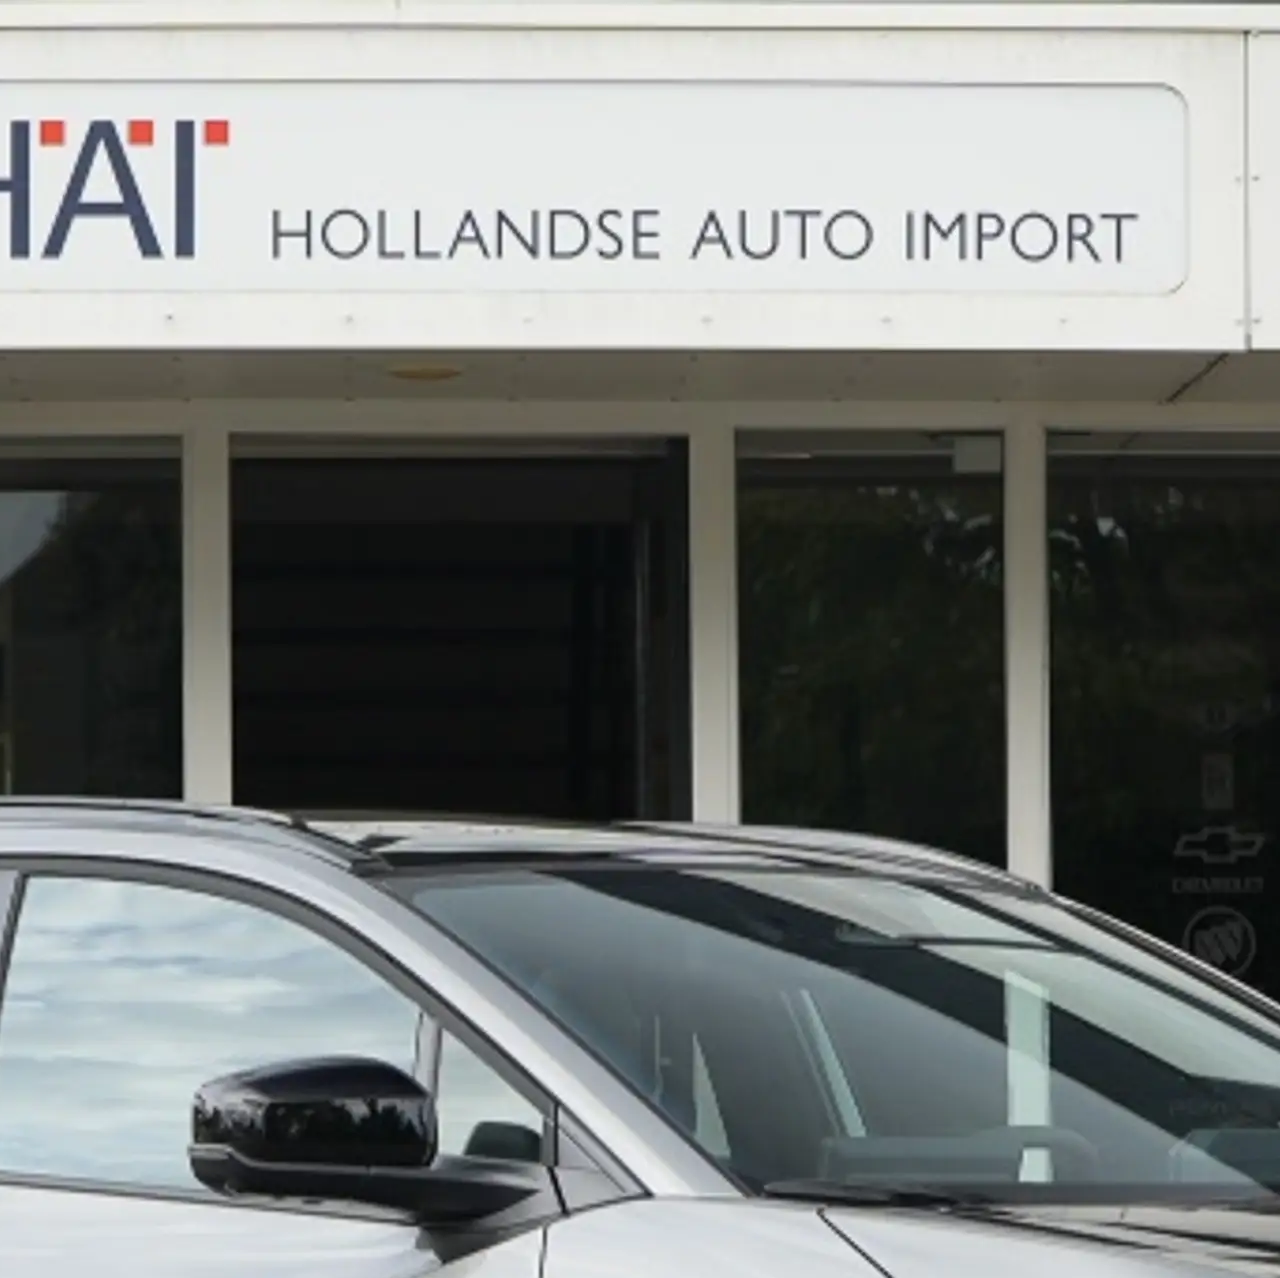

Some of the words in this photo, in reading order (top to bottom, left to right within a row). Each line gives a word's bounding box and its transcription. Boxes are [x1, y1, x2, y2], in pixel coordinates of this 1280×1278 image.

[271, 208, 661, 261] HOLLANDSE
[689, 208, 874, 261] AUTO
[905, 209, 1139, 263] IMPORT
